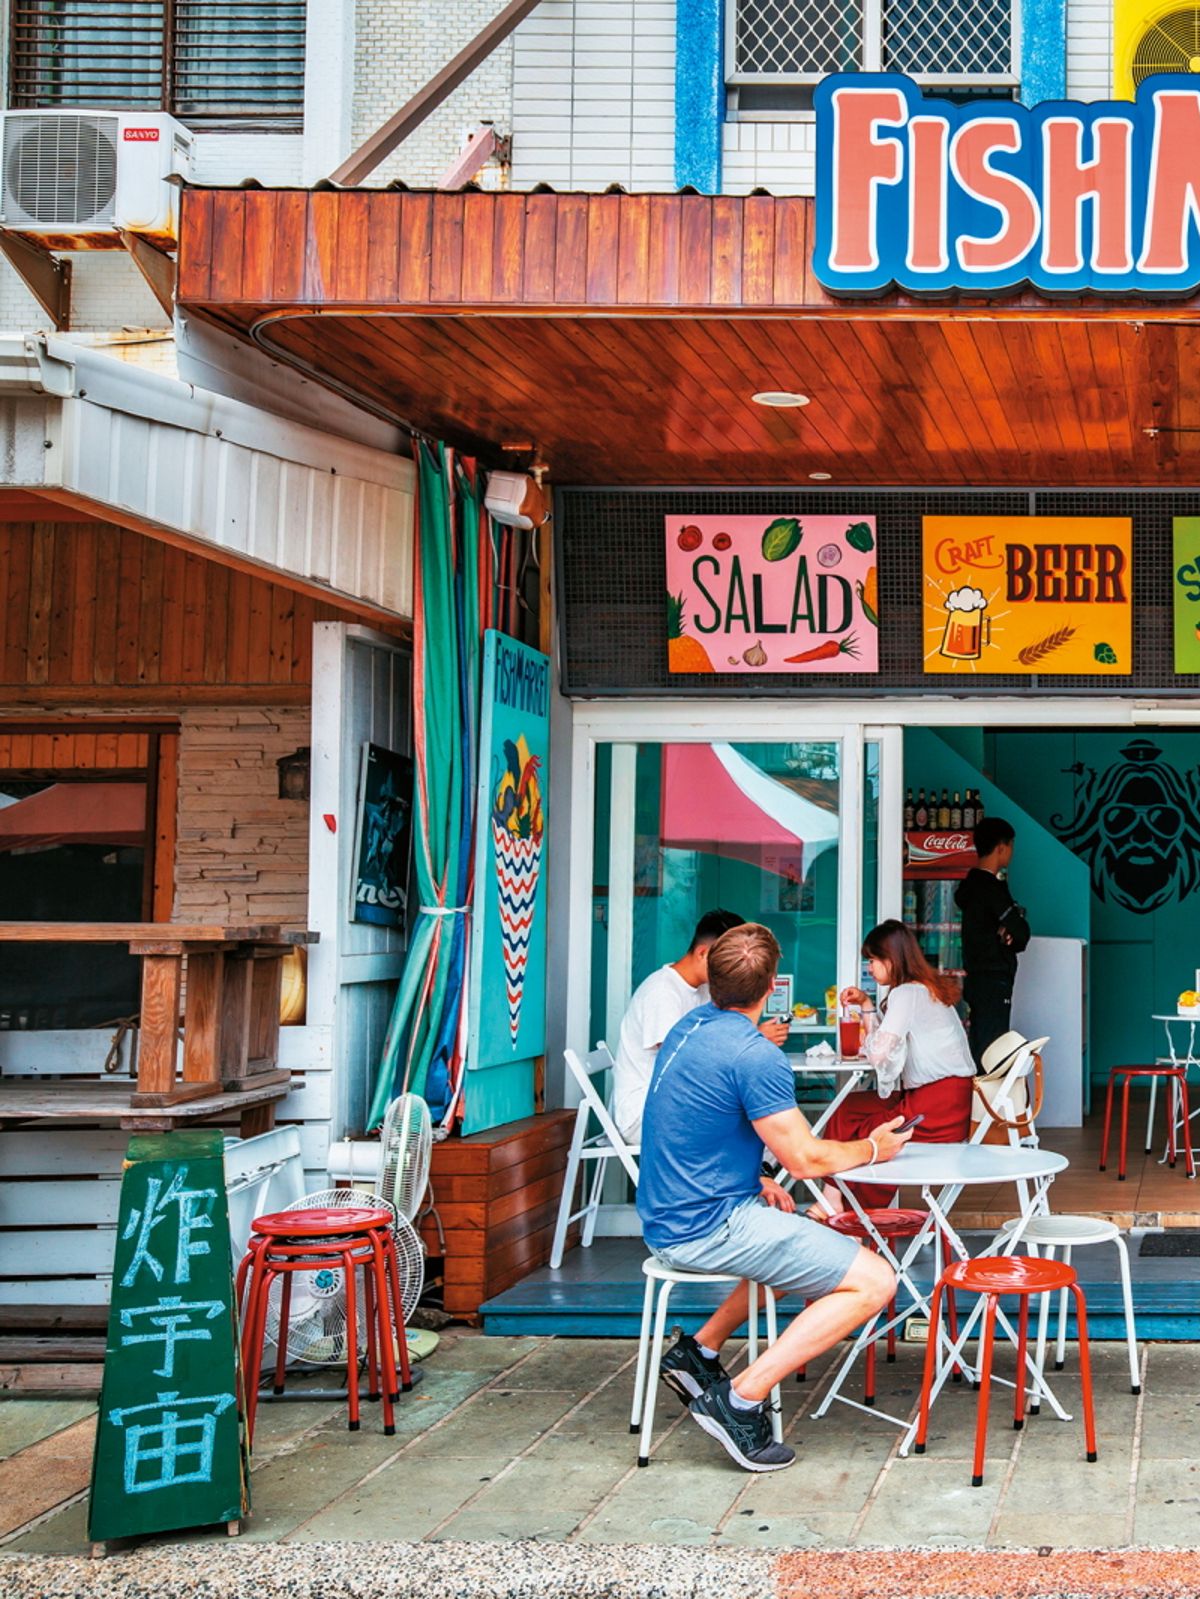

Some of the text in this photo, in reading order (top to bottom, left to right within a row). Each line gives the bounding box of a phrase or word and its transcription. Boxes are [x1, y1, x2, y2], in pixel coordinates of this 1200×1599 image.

[125, 130, 158, 139] SANYO
[692, 554, 853, 635] SALAD
[935, 535, 1129, 604] CRAFT BEER
[109, 1163, 237, 1494] 炸宇宙
